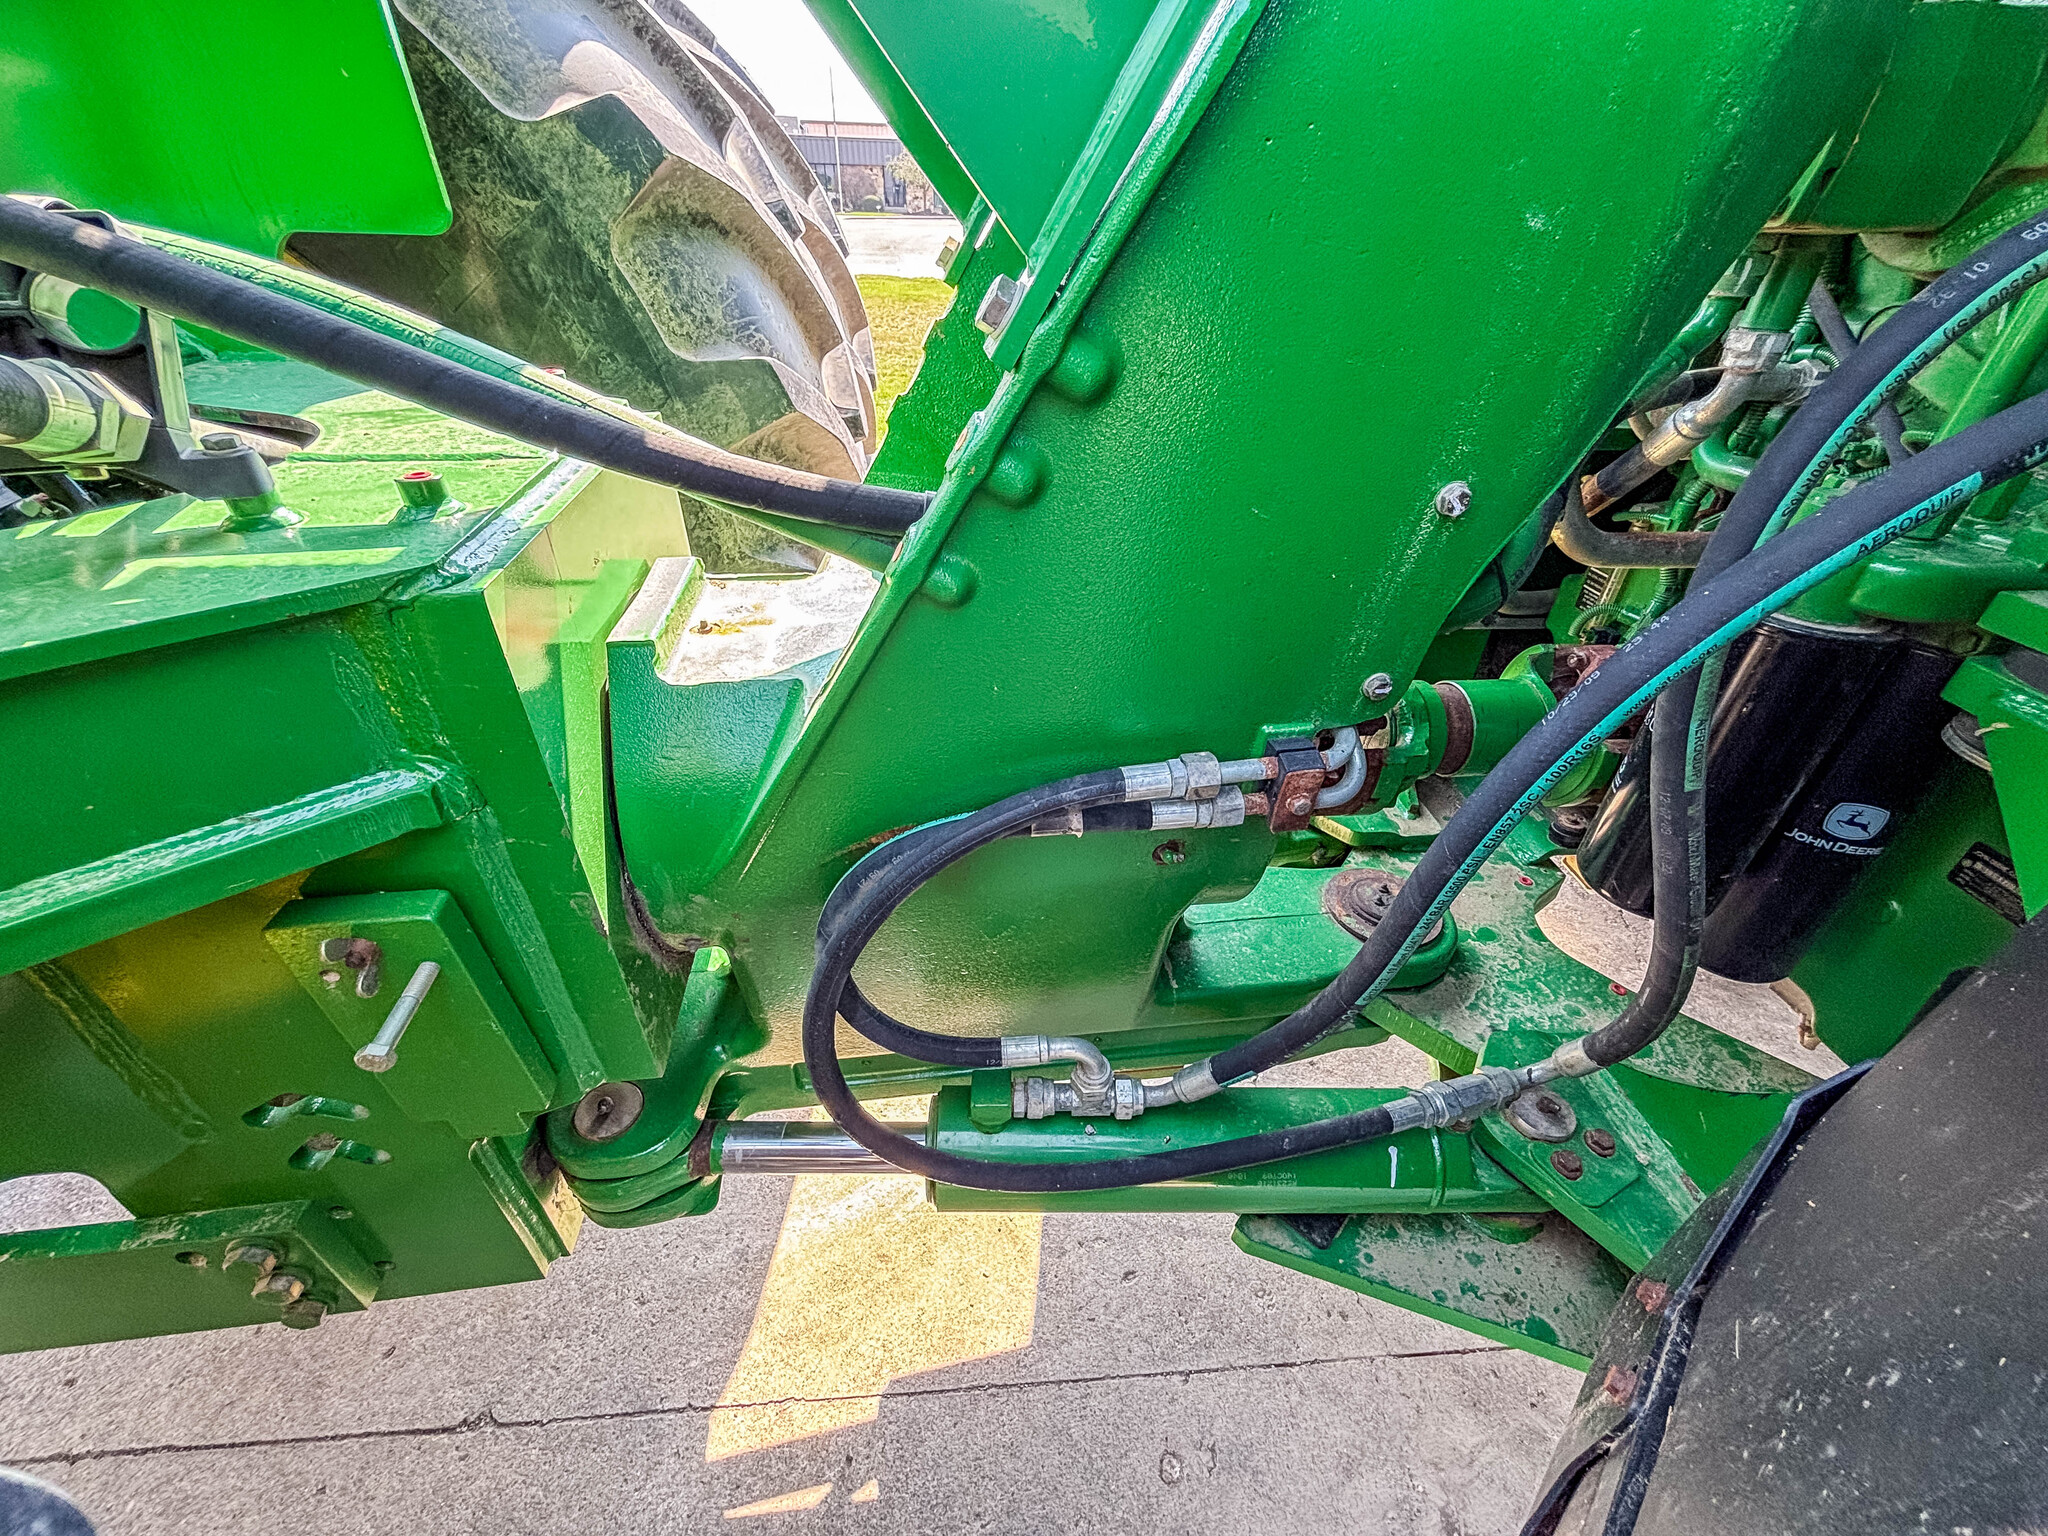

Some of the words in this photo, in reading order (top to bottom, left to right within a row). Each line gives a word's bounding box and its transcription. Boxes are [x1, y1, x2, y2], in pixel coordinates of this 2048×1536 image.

[1855, 487, 1964, 558] AEROQUIP
[1431, 896, 1447, 919] BAR
[1443, 872, 1467, 898] (3500
[1482, 816, 1517, 850] EN857
[1514, 793, 1540, 816] 2SC
[1545, 733, 1602, 785] 100R16S
[1784, 828, 1834, 850] JOHN
[1832, 842, 1885, 856] DEERE
